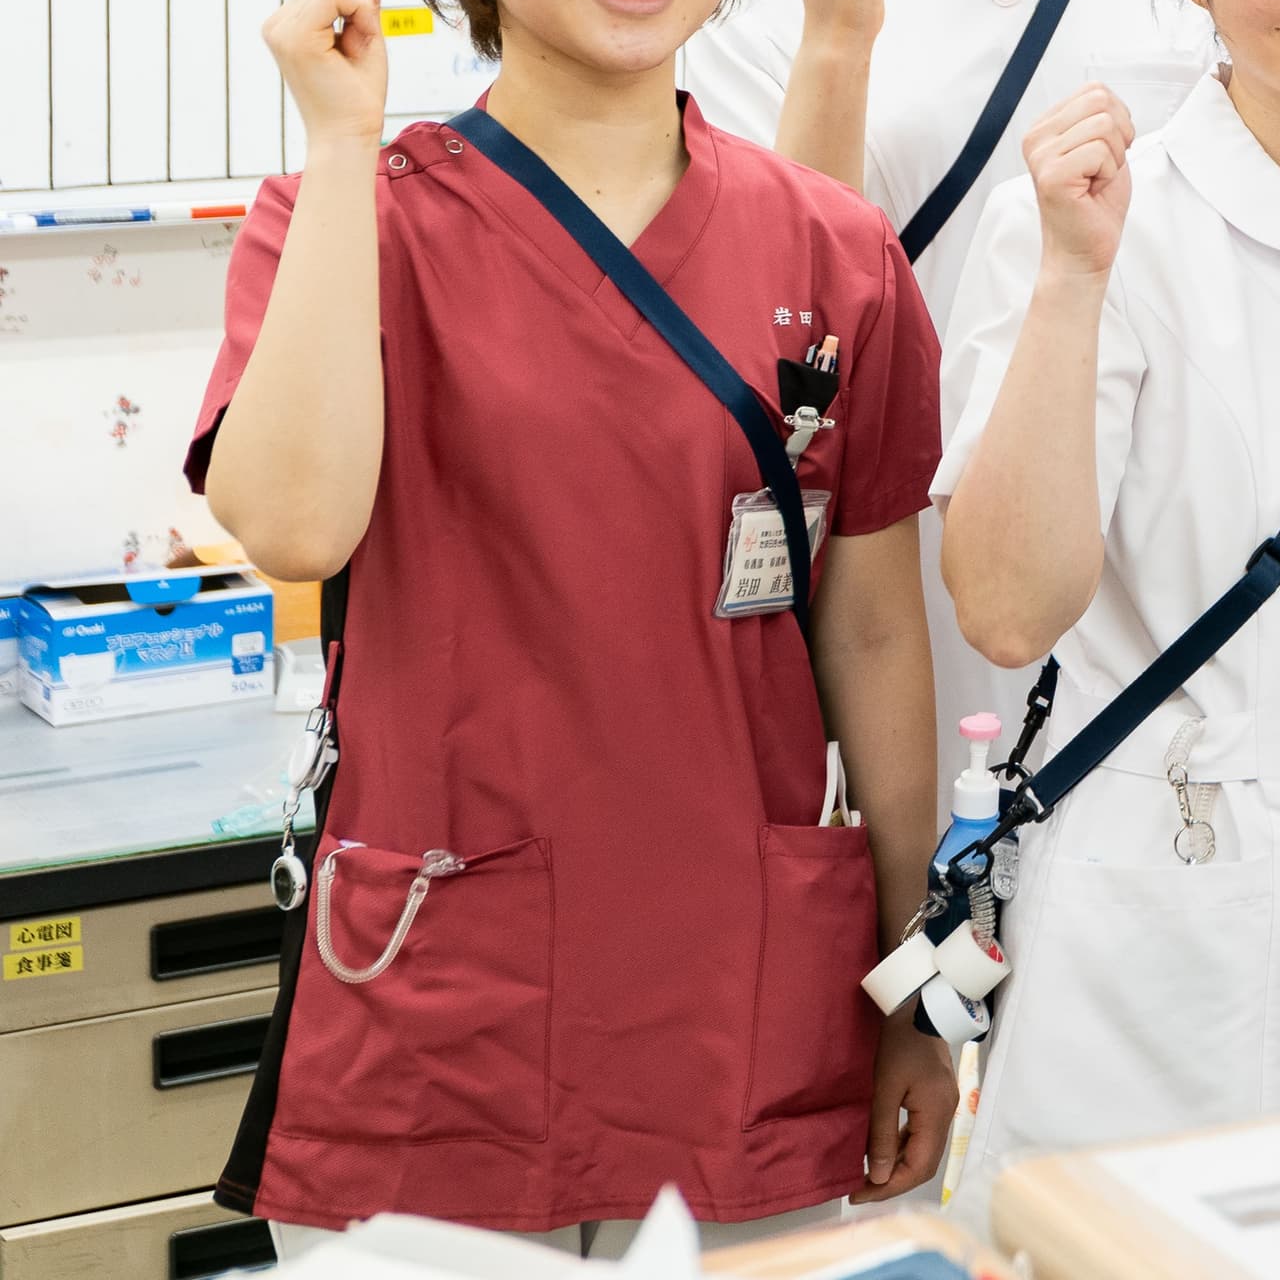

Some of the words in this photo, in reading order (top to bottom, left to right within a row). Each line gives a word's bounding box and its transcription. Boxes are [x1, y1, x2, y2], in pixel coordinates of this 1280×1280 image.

[773, 306, 813, 327] 岩田
[735, 577, 761, 599] 岩田
[16, 921, 73, 945] 心電図
[15, 950, 72, 975] 食事箋
